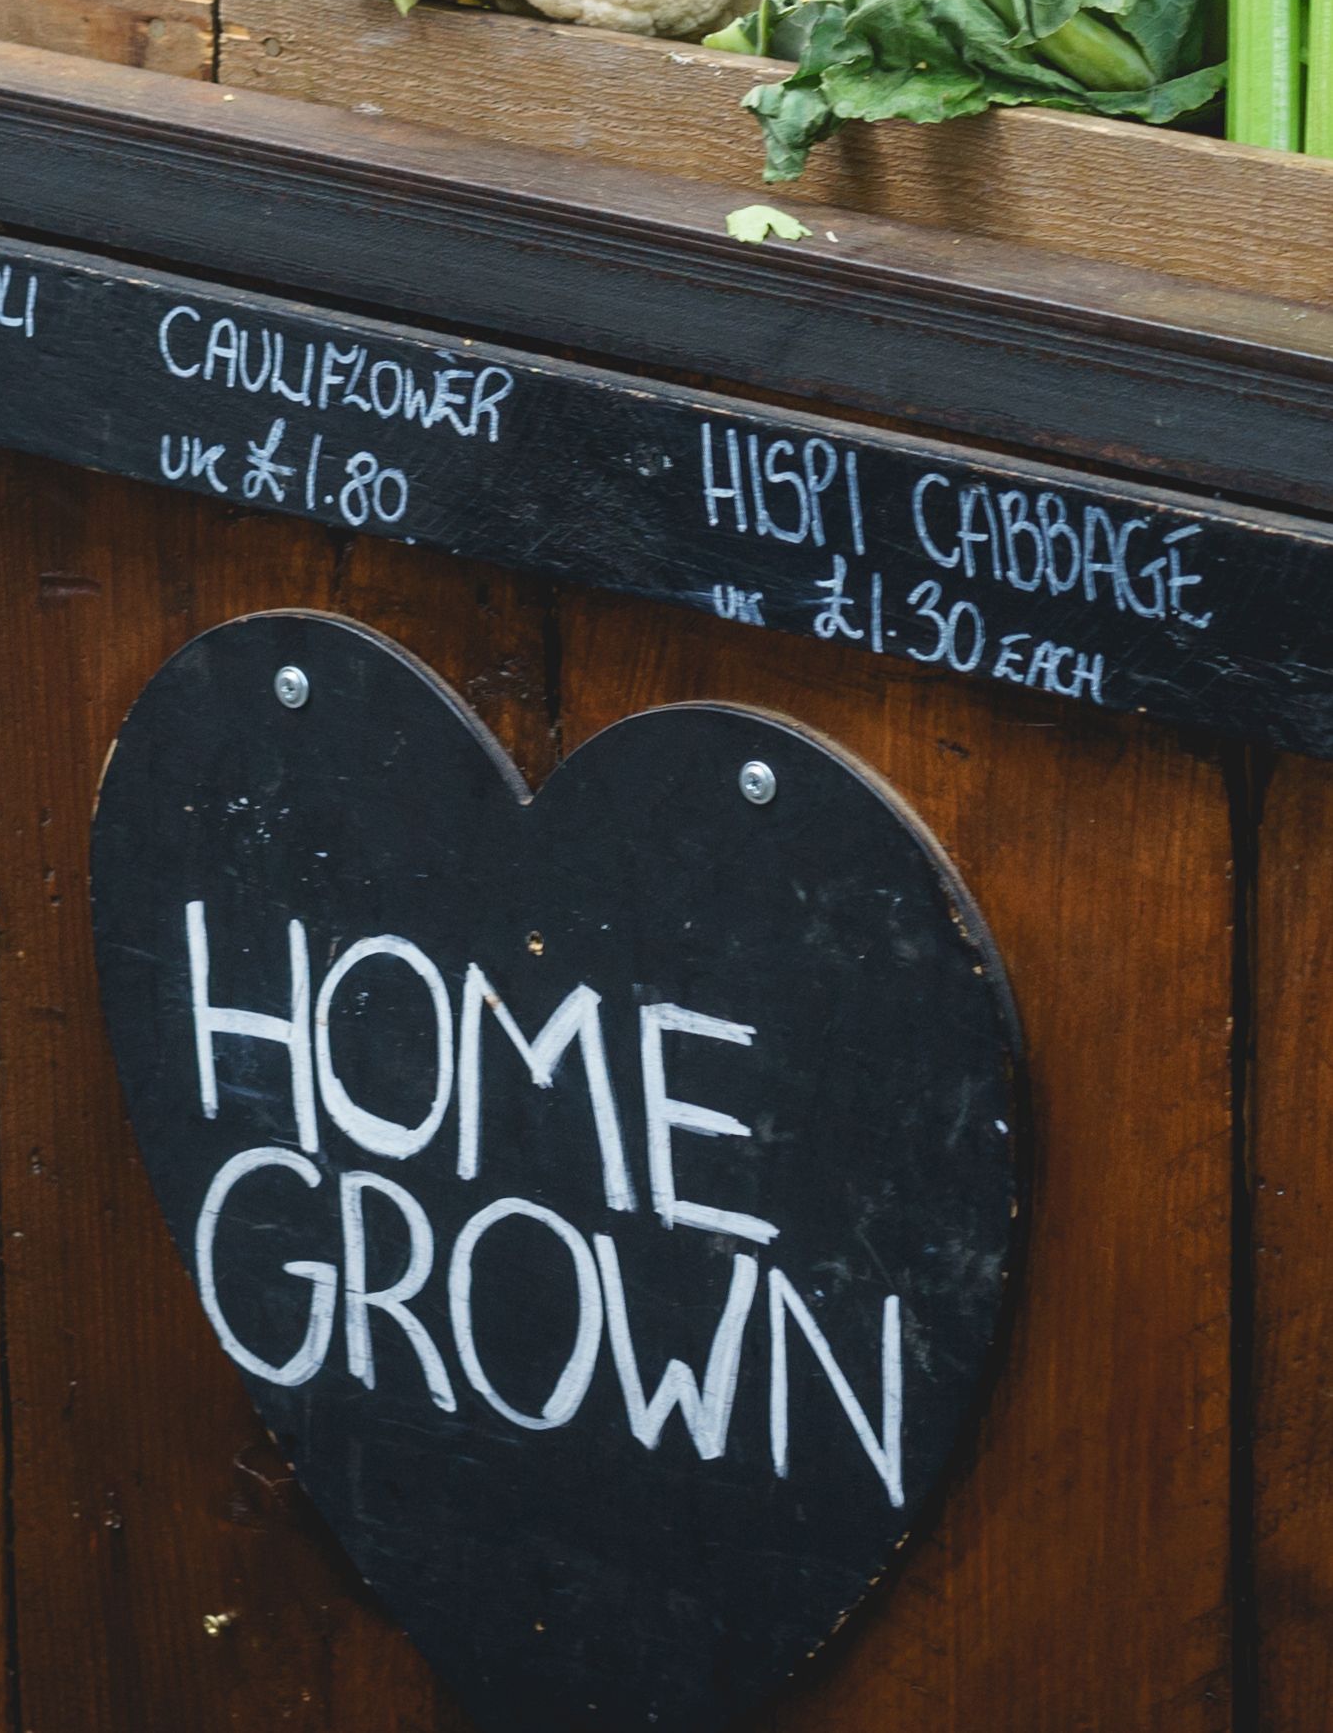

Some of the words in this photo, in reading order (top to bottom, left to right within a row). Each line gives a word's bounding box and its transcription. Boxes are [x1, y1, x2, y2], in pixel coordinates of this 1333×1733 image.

[159, 305, 516, 443] CAULIFLOWER
[161, 434, 229, 493] UK
[242, 417, 409, 527] £1.80
[700, 422, 866, 556] HISPI
[912, 472, 1213, 630] CABBAGE
[813, 554, 986, 672] £1.30
[991, 632, 1104, 705] EACH
[184, 899, 782, 1247] HOME
[194, 1145, 907, 1509] GROWN
